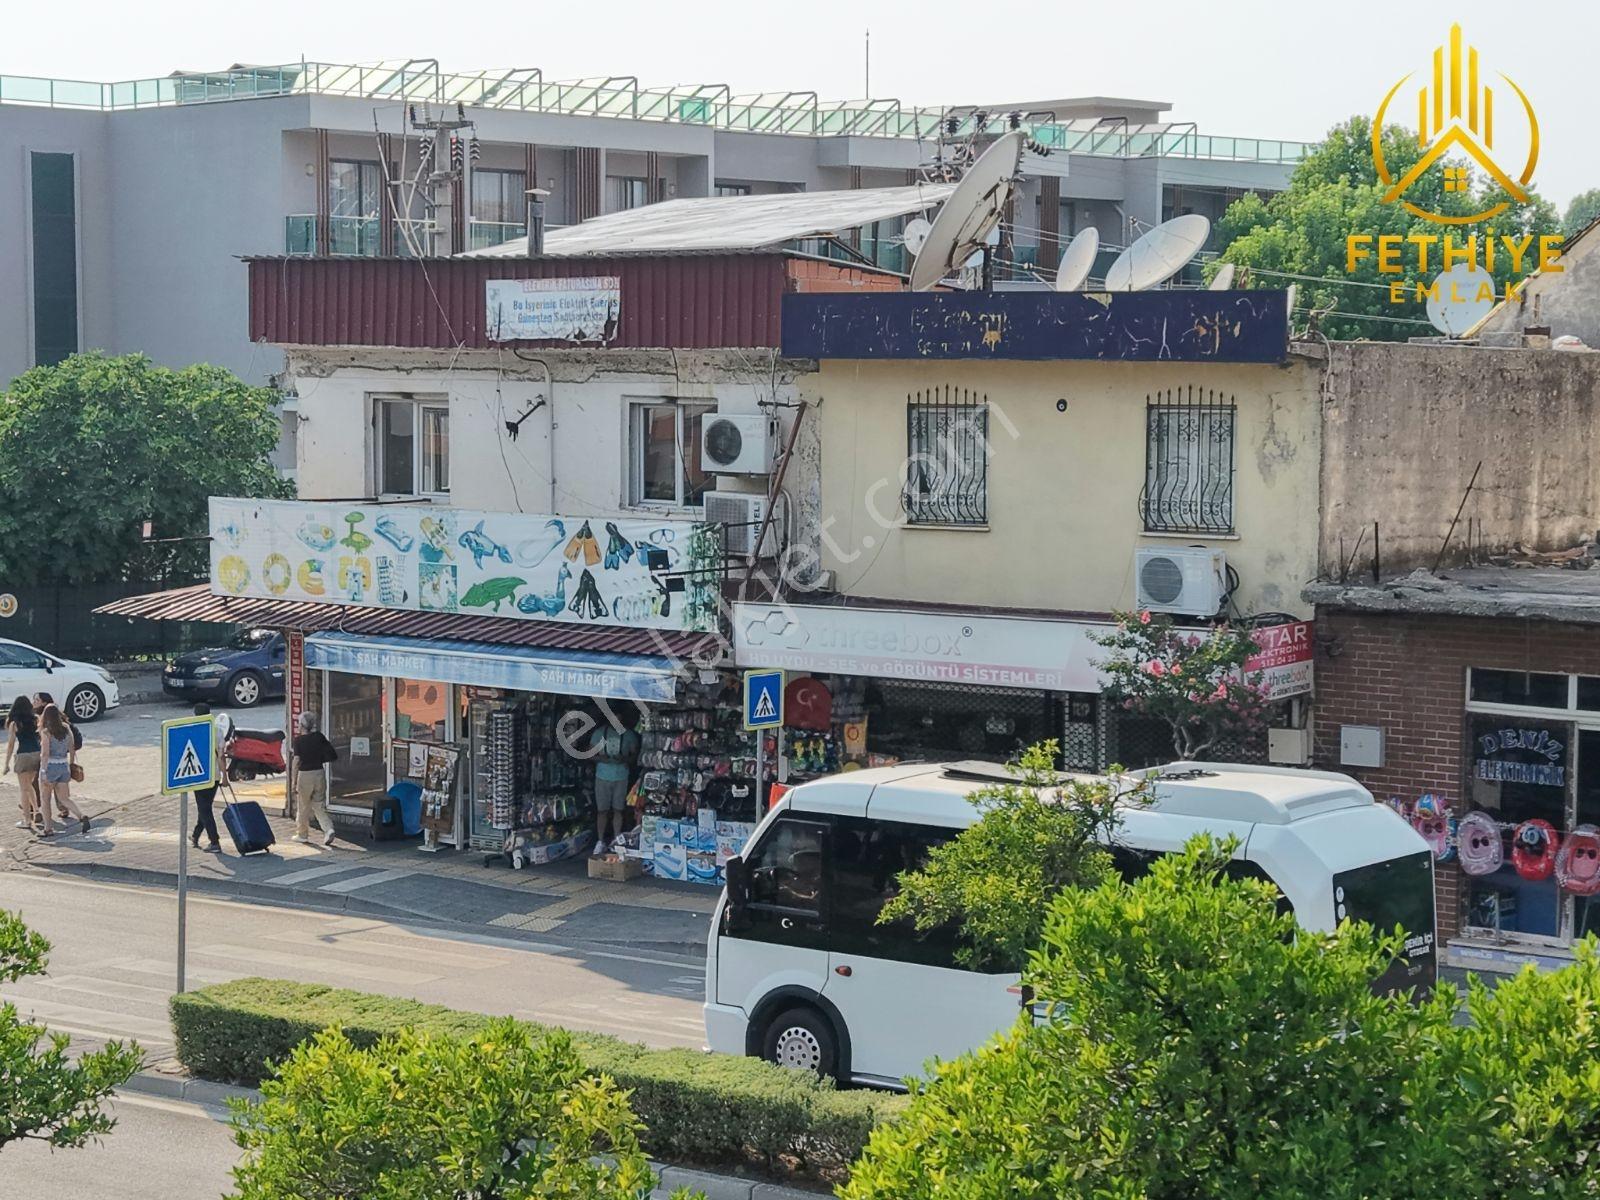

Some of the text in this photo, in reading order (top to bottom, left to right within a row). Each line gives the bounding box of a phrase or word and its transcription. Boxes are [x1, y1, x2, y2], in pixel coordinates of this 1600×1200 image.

[381, 654, 426, 669] MARKET
[773, 654, 814, 668] UYDU
[829, 658, 857, 671] SES
[883, 660, 959, 679] GÖRÜNTÜ
[963, 665, 1063, 686] SİSTEMLERİ
[567, 672, 616, 688] MARKET
